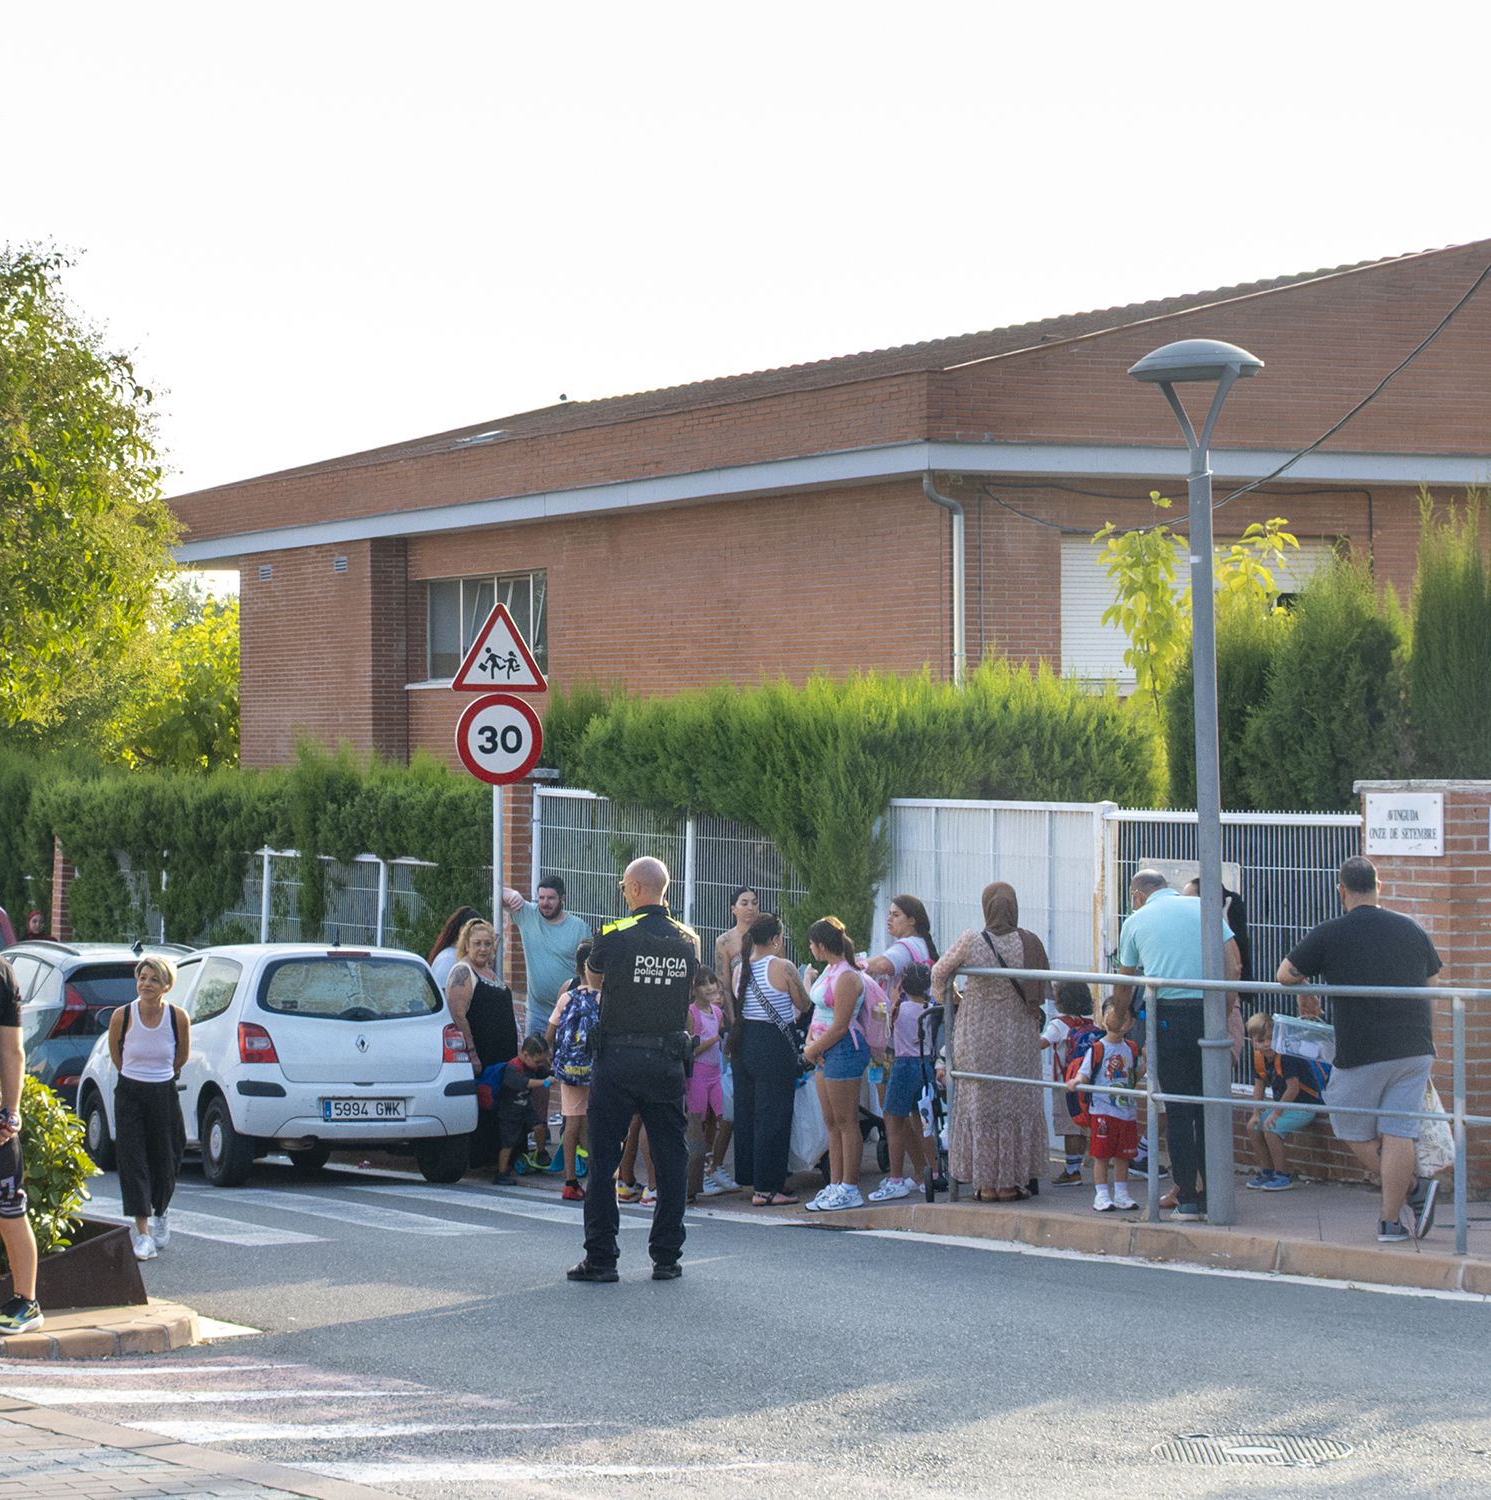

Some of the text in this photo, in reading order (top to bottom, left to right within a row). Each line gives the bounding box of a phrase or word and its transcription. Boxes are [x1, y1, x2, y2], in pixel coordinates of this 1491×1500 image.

[477, 725, 523, 754] 30
[1369, 828, 1437, 839] ONZE DE SETEMBRE
[635, 955, 687, 970] POLICIA
[667, 968, 687, 978] local
[334, 1102, 401, 1117] 5994 GWK
